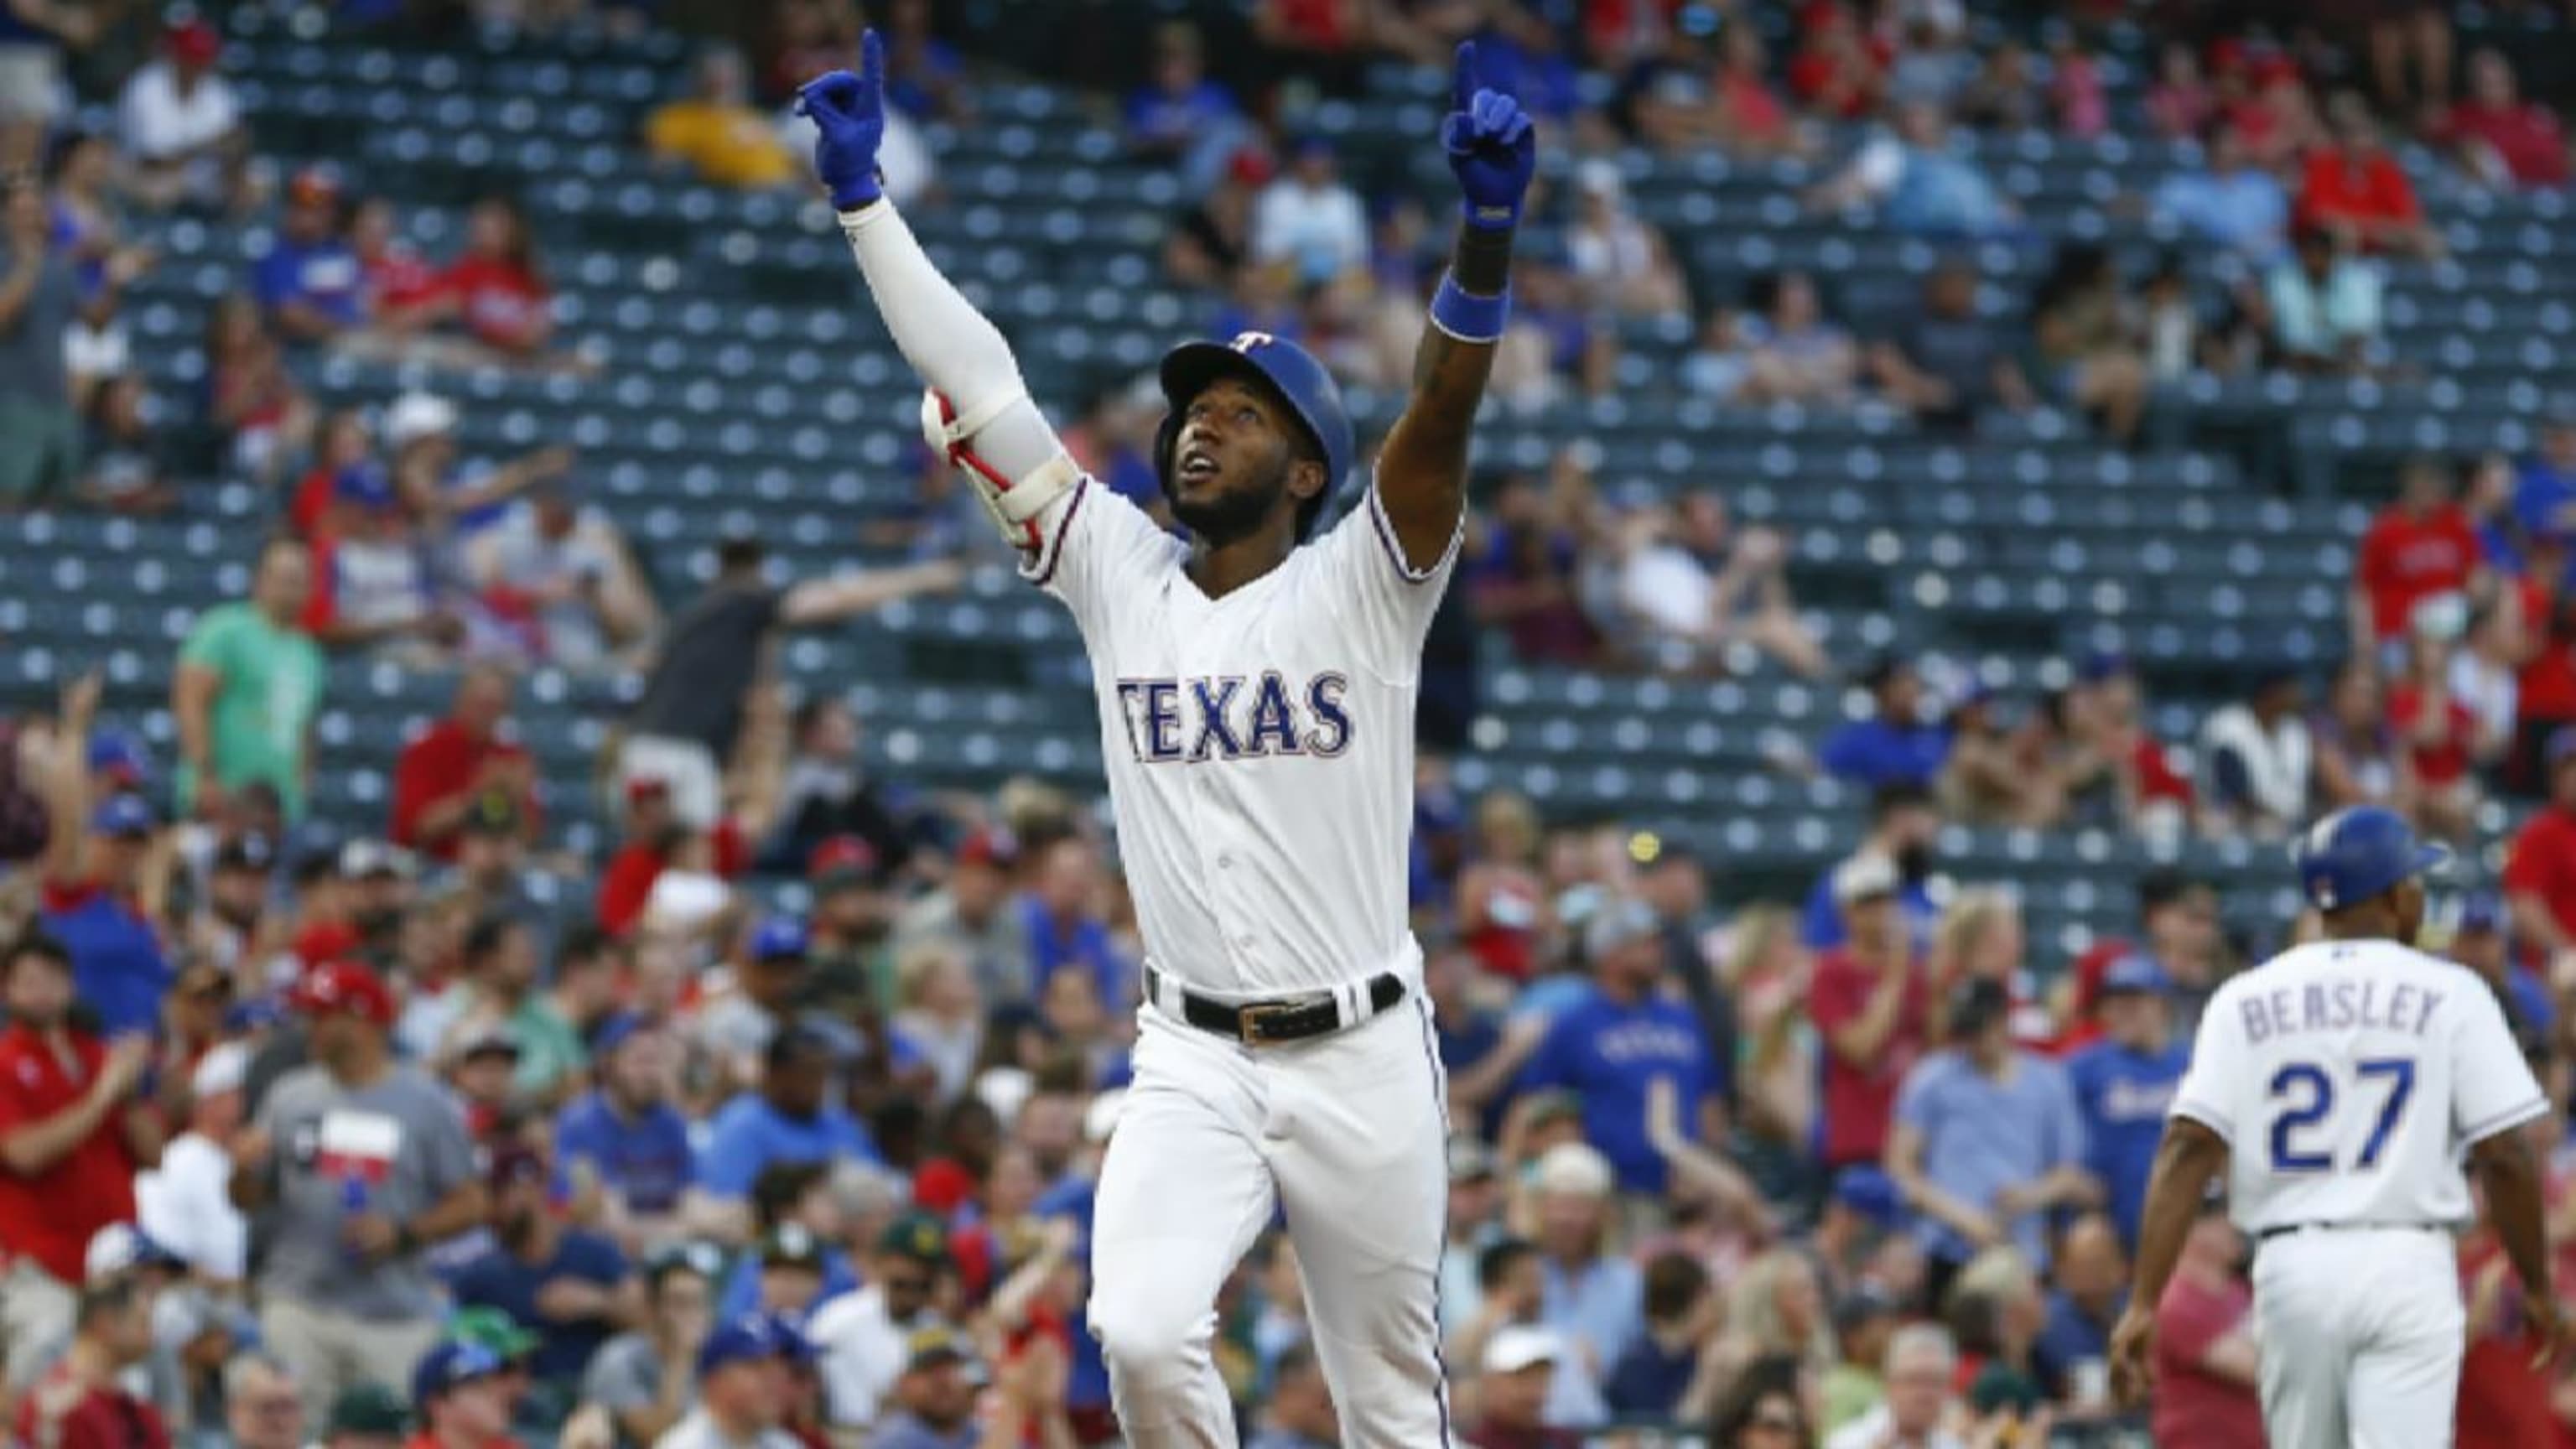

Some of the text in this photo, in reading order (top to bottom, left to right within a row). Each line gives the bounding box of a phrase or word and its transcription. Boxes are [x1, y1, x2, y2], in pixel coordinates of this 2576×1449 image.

[1116, 670, 1354, 763] TEXAS
[2241, 979, 2444, 1043] BEASLEY
[2267, 1056, 2418, 1171] 27
